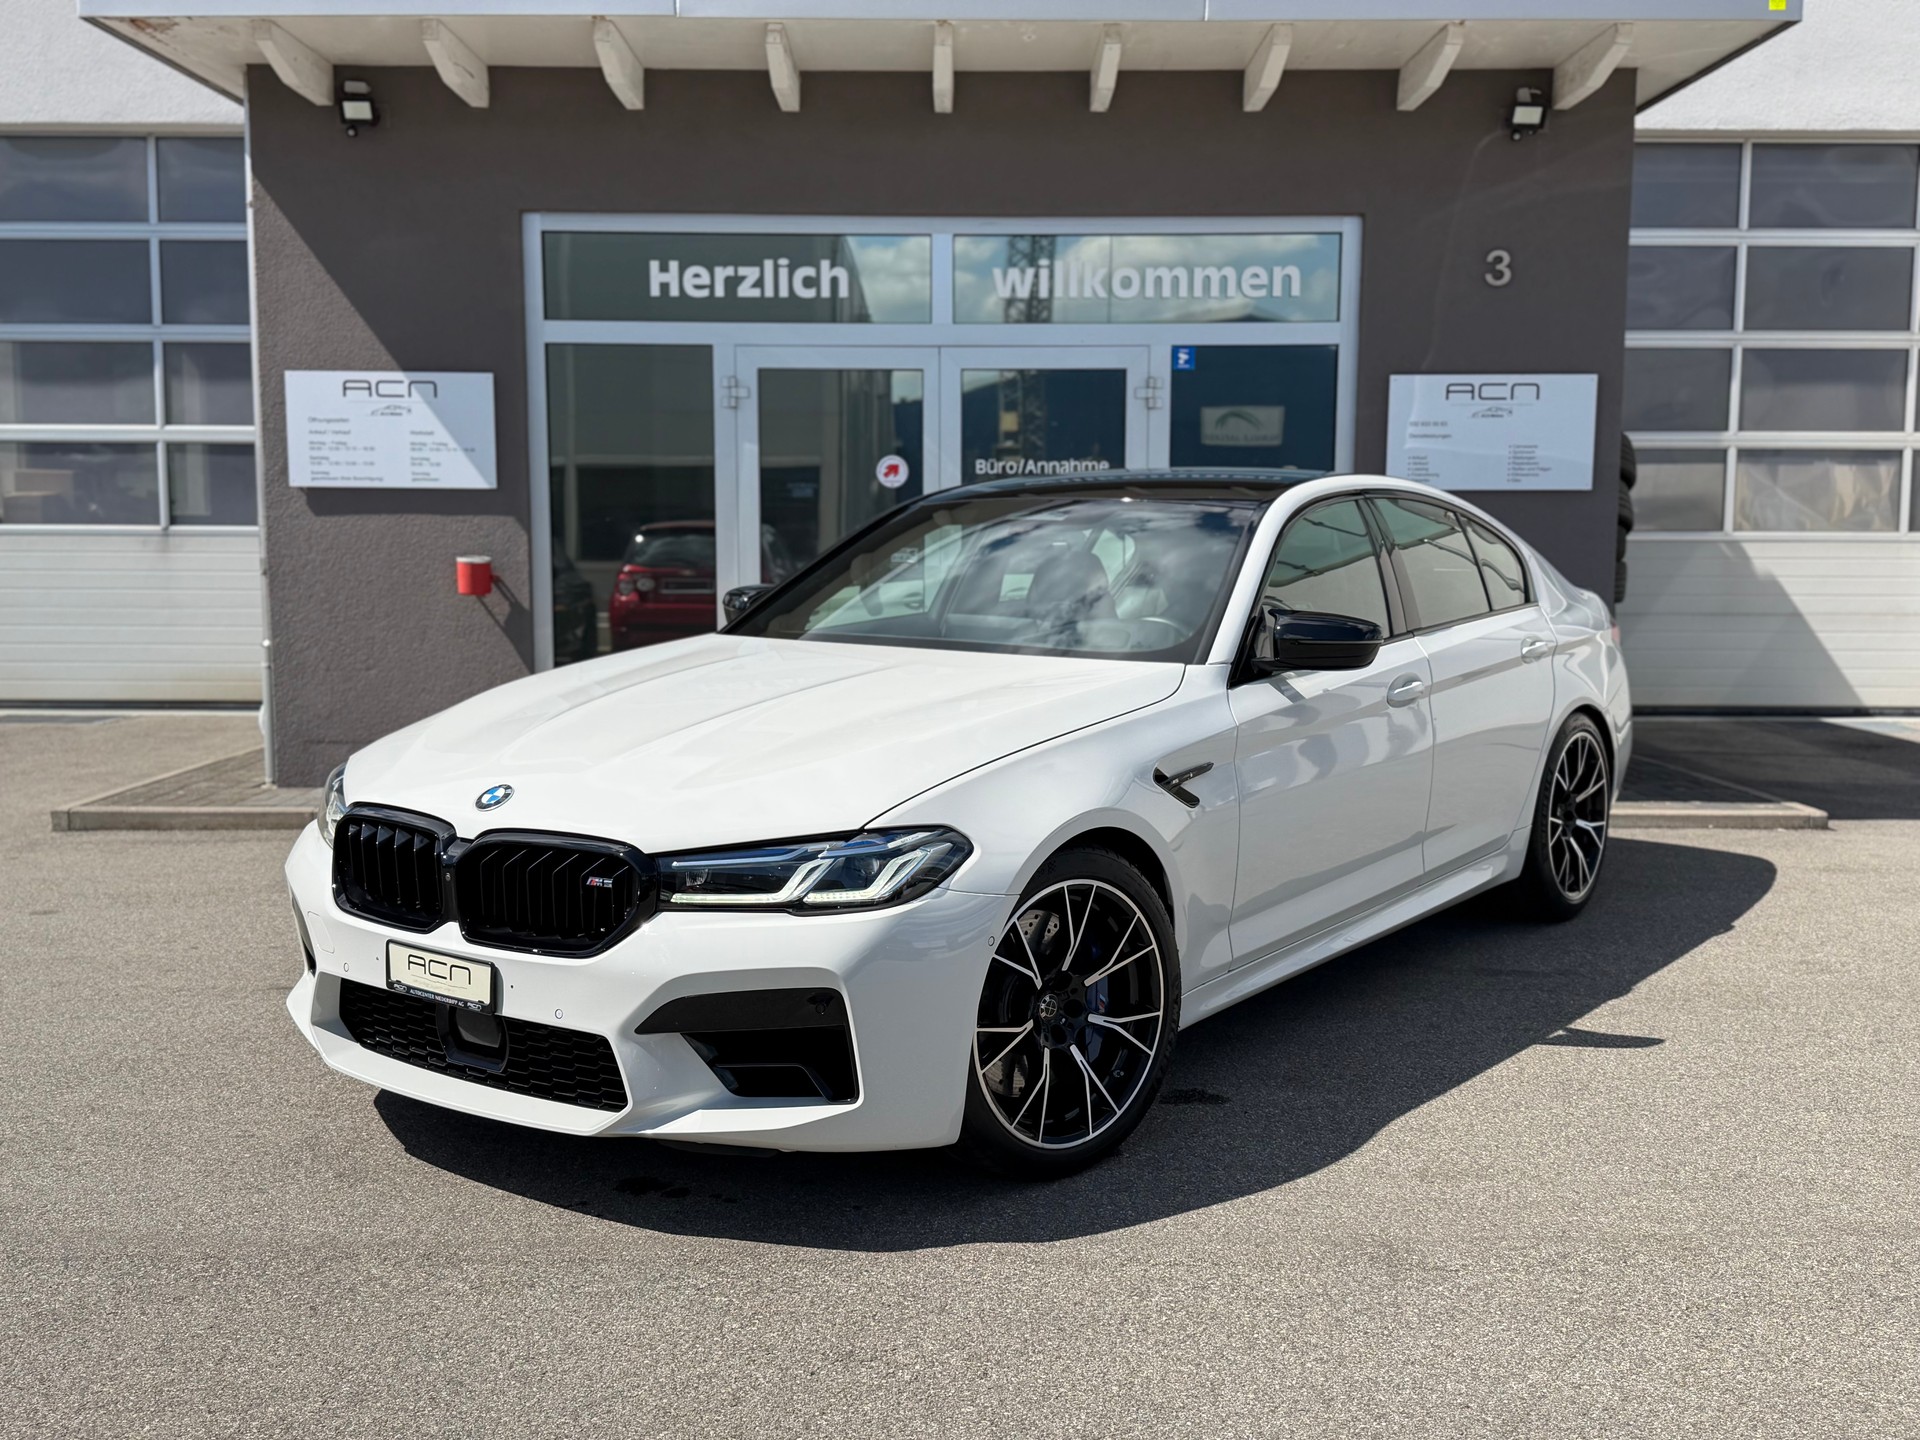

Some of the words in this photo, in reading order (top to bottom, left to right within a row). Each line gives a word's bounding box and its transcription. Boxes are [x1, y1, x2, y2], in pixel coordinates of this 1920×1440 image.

[649, 257, 850, 299] Herzlich
[992, 259, 1300, 299] willkommen
[1485, 249, 1512, 287] 3
[975, 458, 1110, 475] Büro/Annahme
